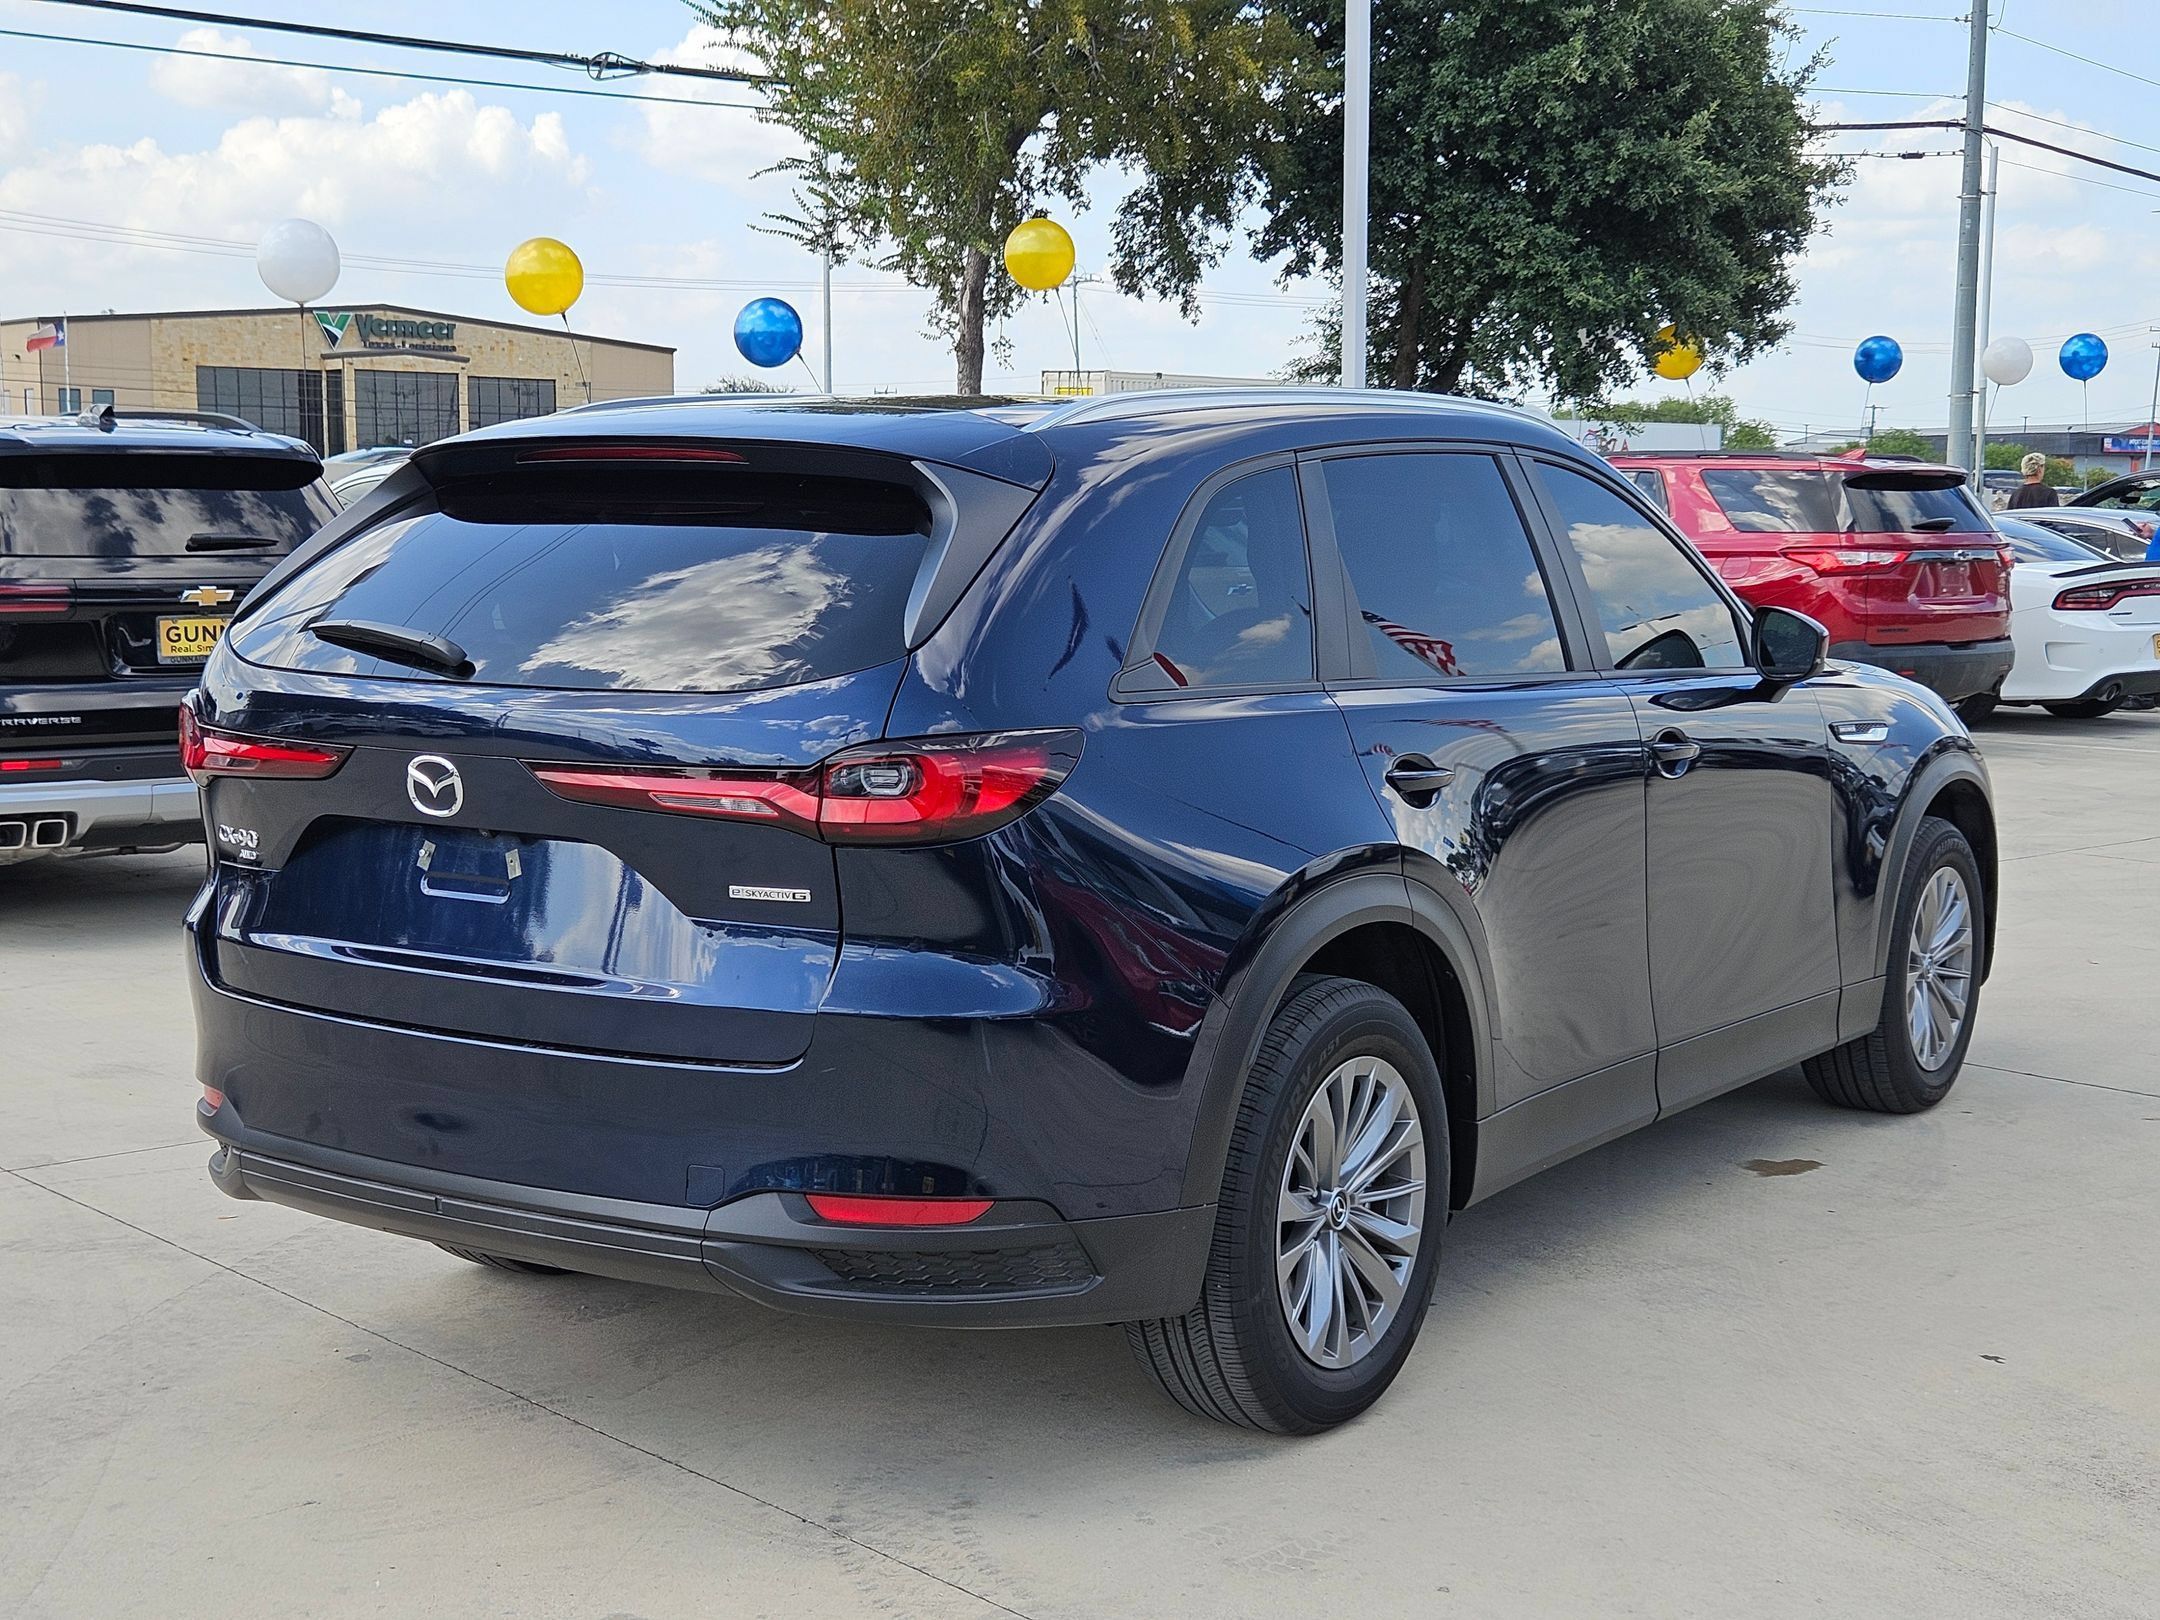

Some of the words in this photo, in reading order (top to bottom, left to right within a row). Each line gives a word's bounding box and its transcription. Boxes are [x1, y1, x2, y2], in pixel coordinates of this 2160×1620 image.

[355, 313, 456, 341] Vermeer
[170, 645, 195, 653] Real.
[0, 716, 82, 726] RAVERSE
[218, 824, 259, 848] CX-90
